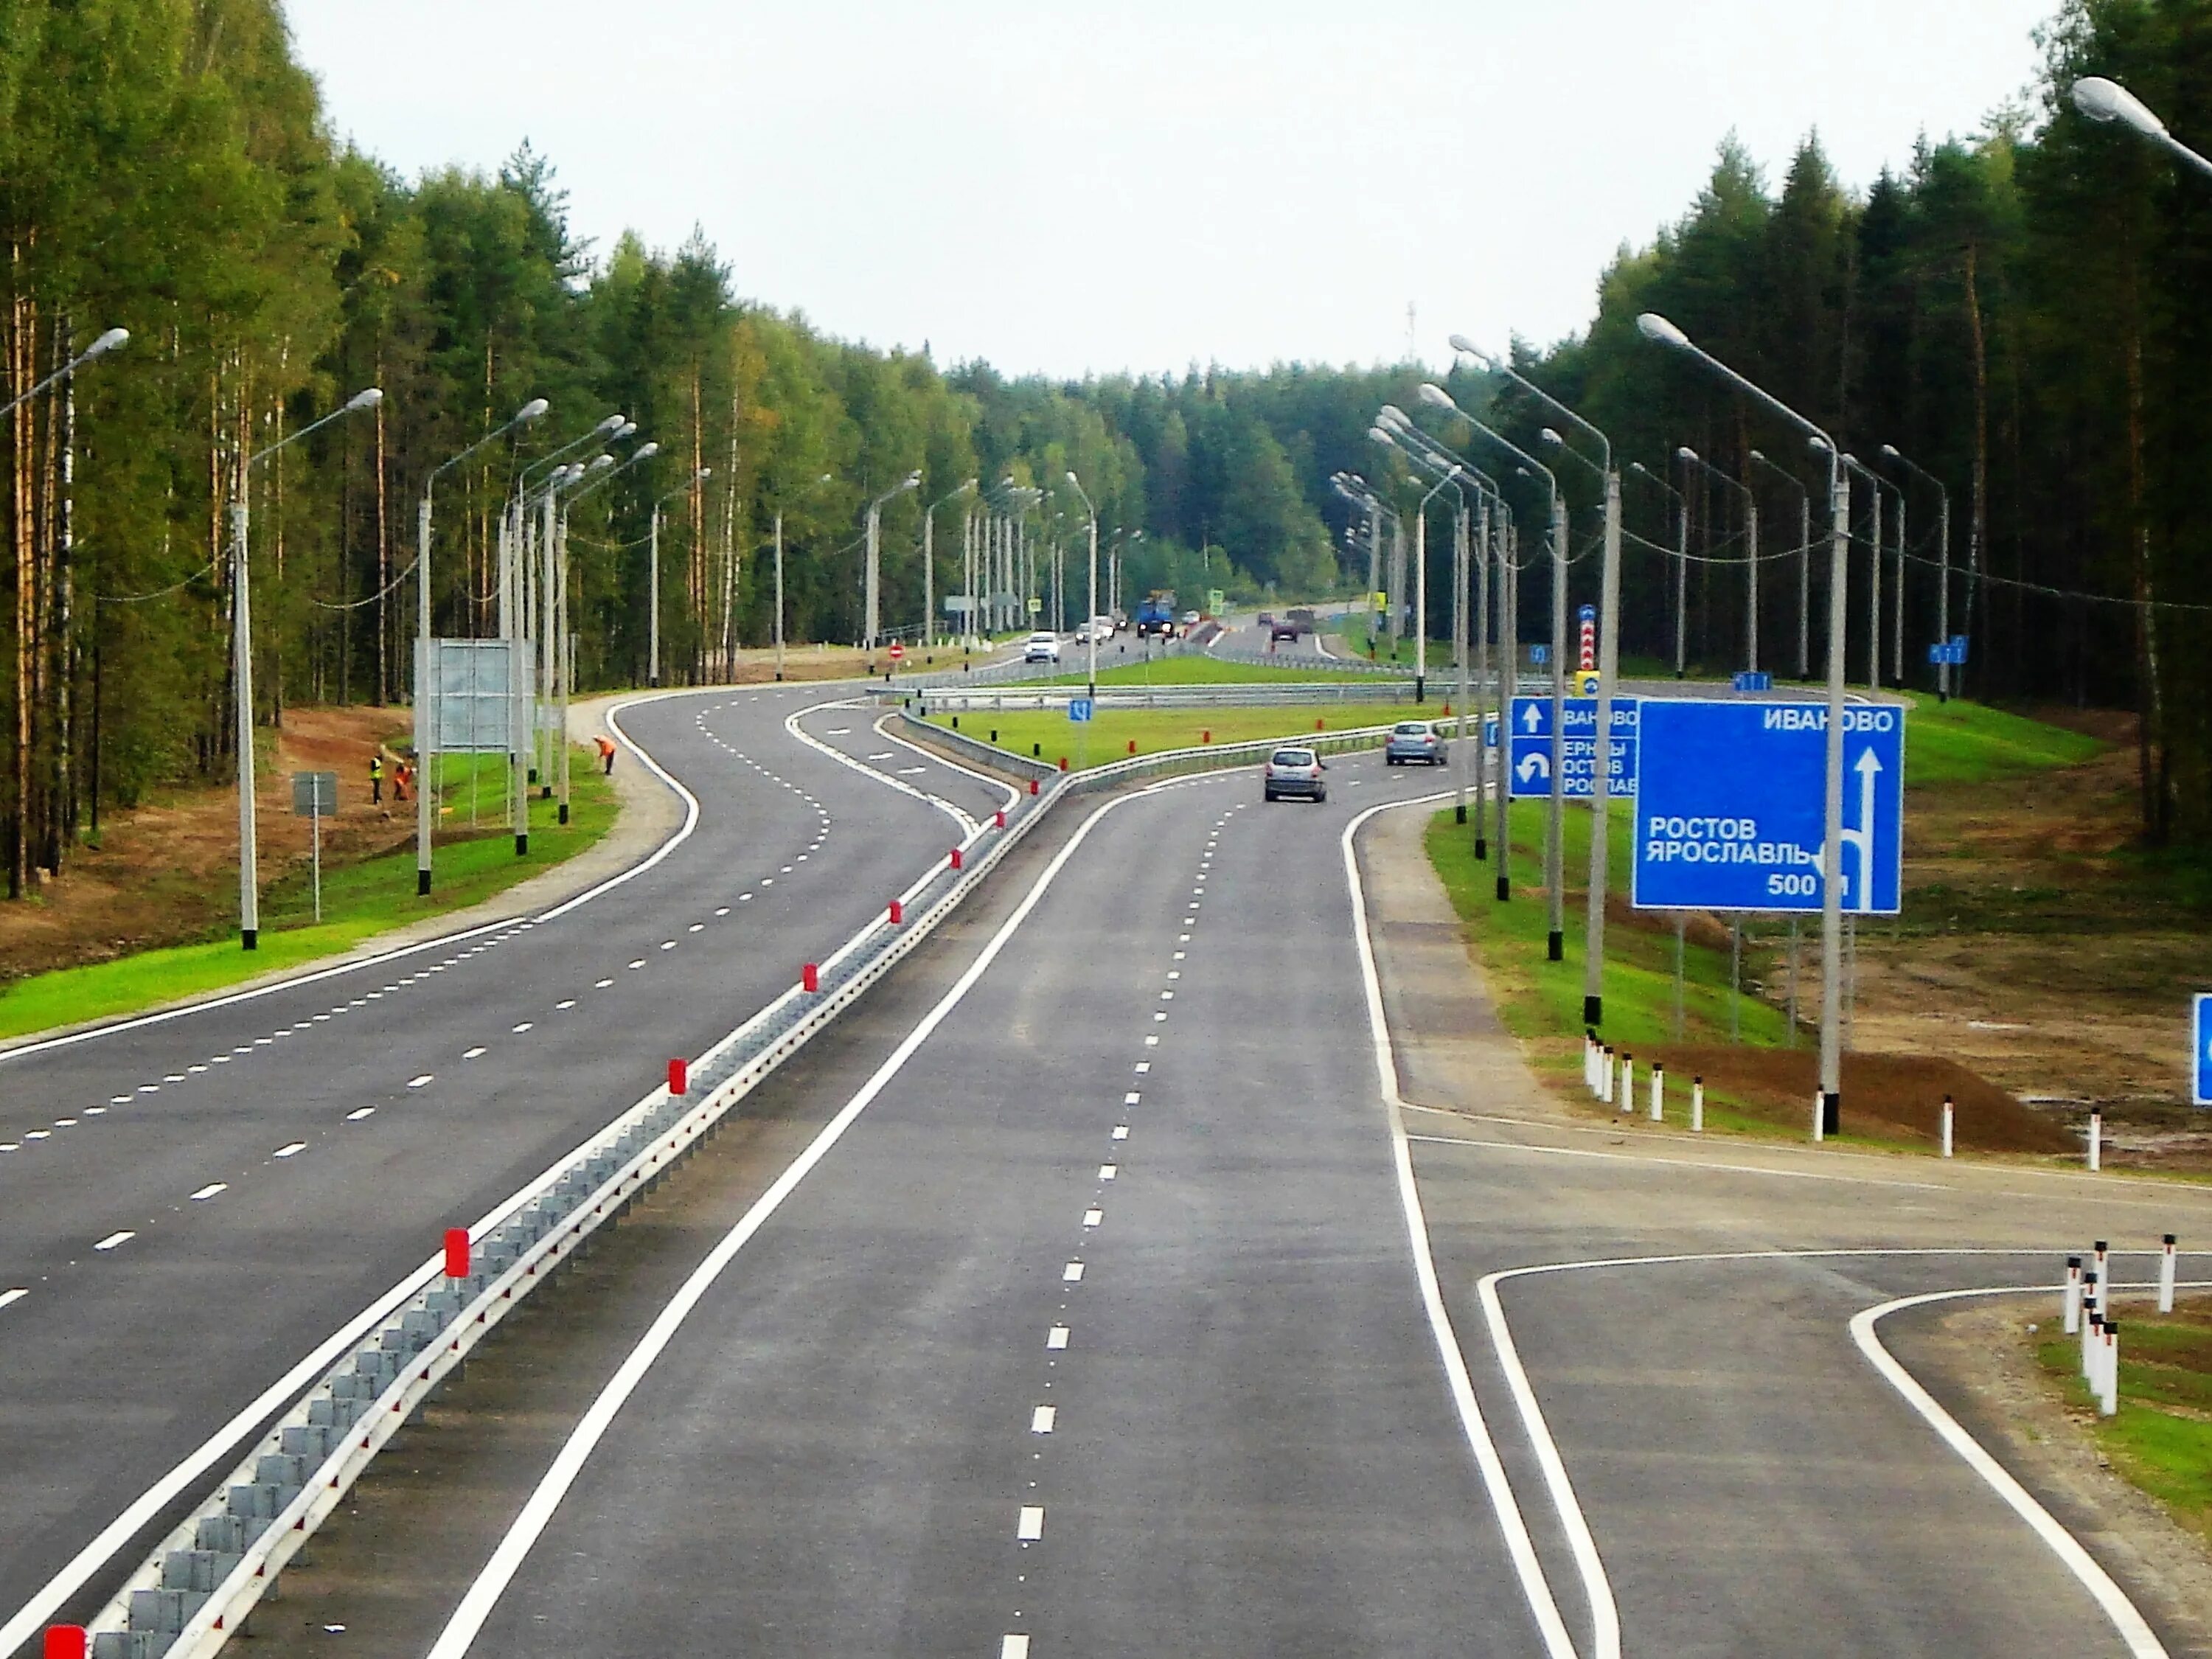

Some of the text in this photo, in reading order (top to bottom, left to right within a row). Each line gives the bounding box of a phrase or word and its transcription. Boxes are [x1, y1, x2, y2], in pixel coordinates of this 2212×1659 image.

[1563, 710, 1638, 726] ВАНВО
[1563, 741, 1627, 757] ЕРНЫ
[1562, 759, 1624, 774] ОСТВ
[1649, 816, 1758, 841] РОСТОВ
[1645, 840, 1811, 865] ЯРОСЛАВЛЬ
[1767, 873, 1817, 896] 500
